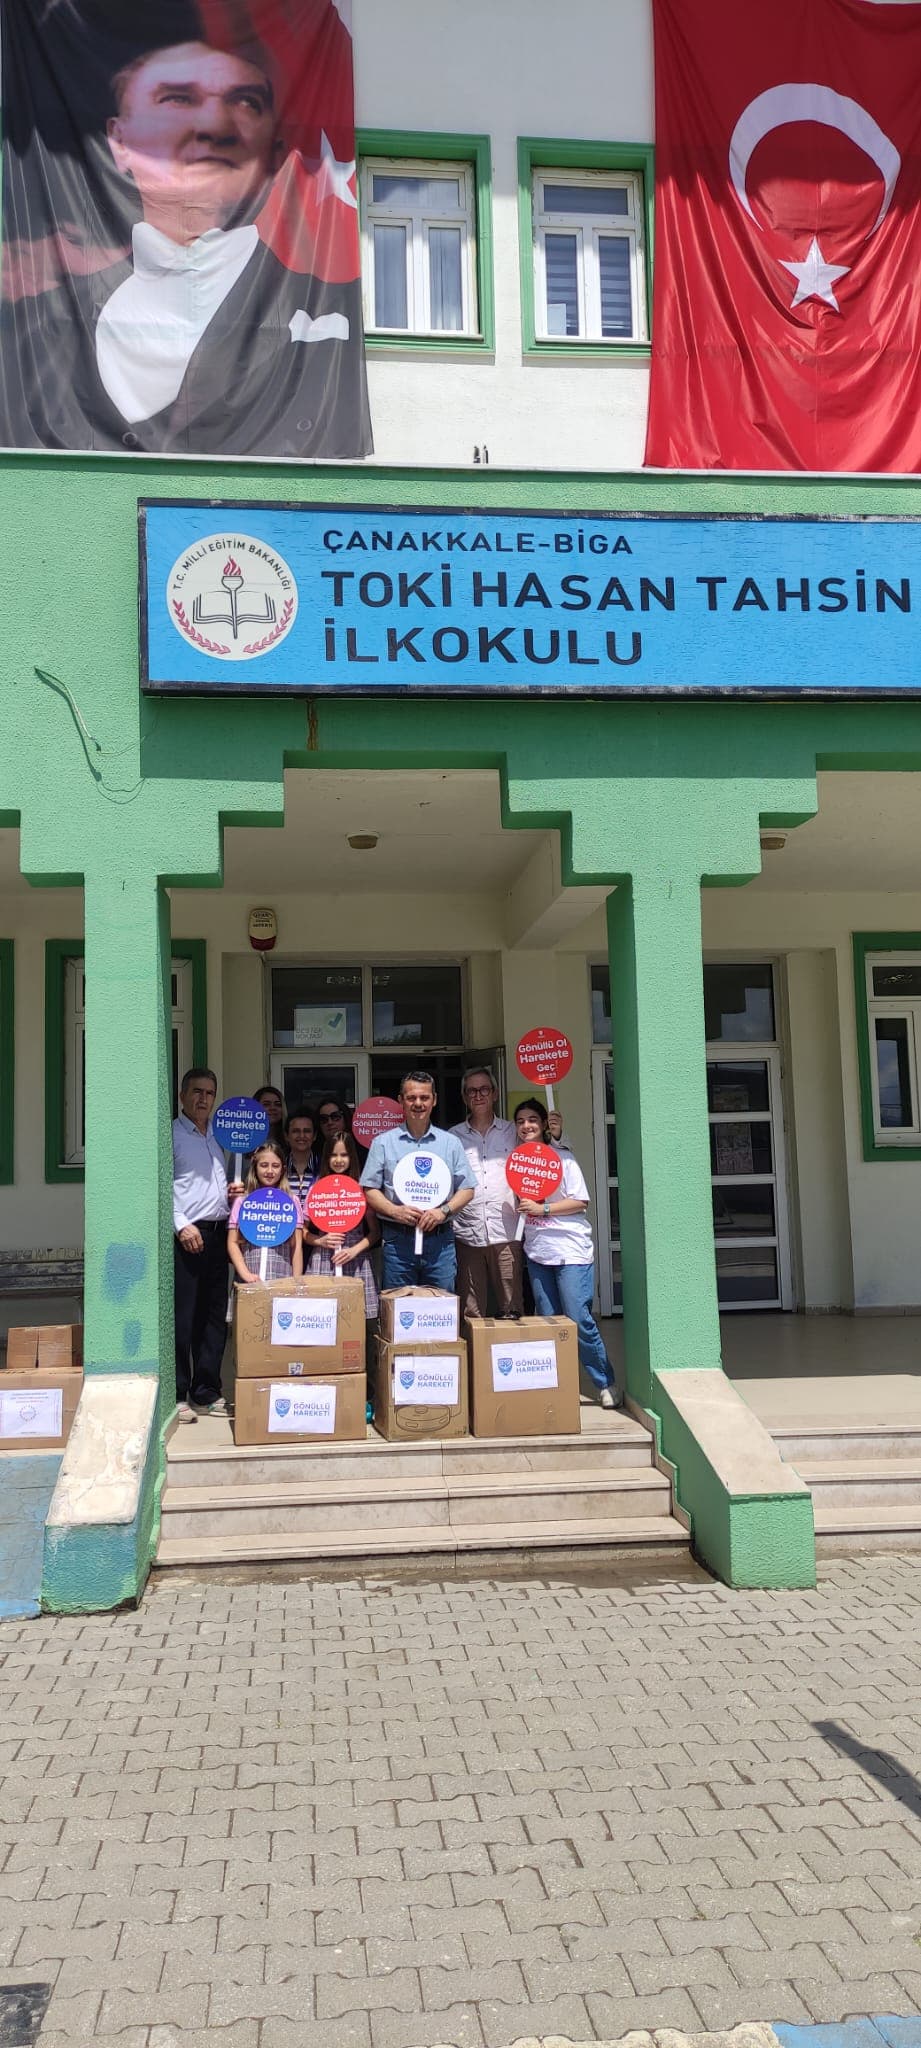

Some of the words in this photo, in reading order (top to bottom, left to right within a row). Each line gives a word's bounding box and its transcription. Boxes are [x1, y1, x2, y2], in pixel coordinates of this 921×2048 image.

[323, 529, 633, 554] ÇANAKKALE-BİGA
[173, 572, 187, 590] T.C.
[182, 546, 208, 571] MİLLİ
[208, 538, 246, 552] EĞİTİM
[248, 544, 291, 591] BAKANLIĞI
[321, 563, 452, 607] TOKİ
[472, 571, 675, 612] HASAN
[696, 569, 911, 613] TAHSİN
[324, 617, 643, 665] İLKOKULU
[518, 1040, 554, 1053] Gönüllü
[556, 1038, 567, 1048] Ol
[520, 1050, 569, 1064] Harekete
[216, 1109, 253, 1119] Gönüllü
[255, 1111, 266, 1120] Ol
[216, 1118, 266, 1131] Harekete
[353, 1119, 381, 1127] Gönüllü
[512, 1152, 548, 1167] Gönüllü
[549, 1160, 560, 1170] Ol
[509, 1161, 558, 1181] Harekete
[312, 1191, 338, 1200] Haftada
[243, 1200, 280, 1211] Gönüllü
[282, 1203, 294, 1212] Ol
[308, 1200, 338, 1209] Gönüllü
[242, 1210, 293, 1223] Harekete
[314, 1209, 327, 1217] Ne
[328, 1207, 360, 1217] Dersin?
[256, 1222, 281, 1234] Geç!
